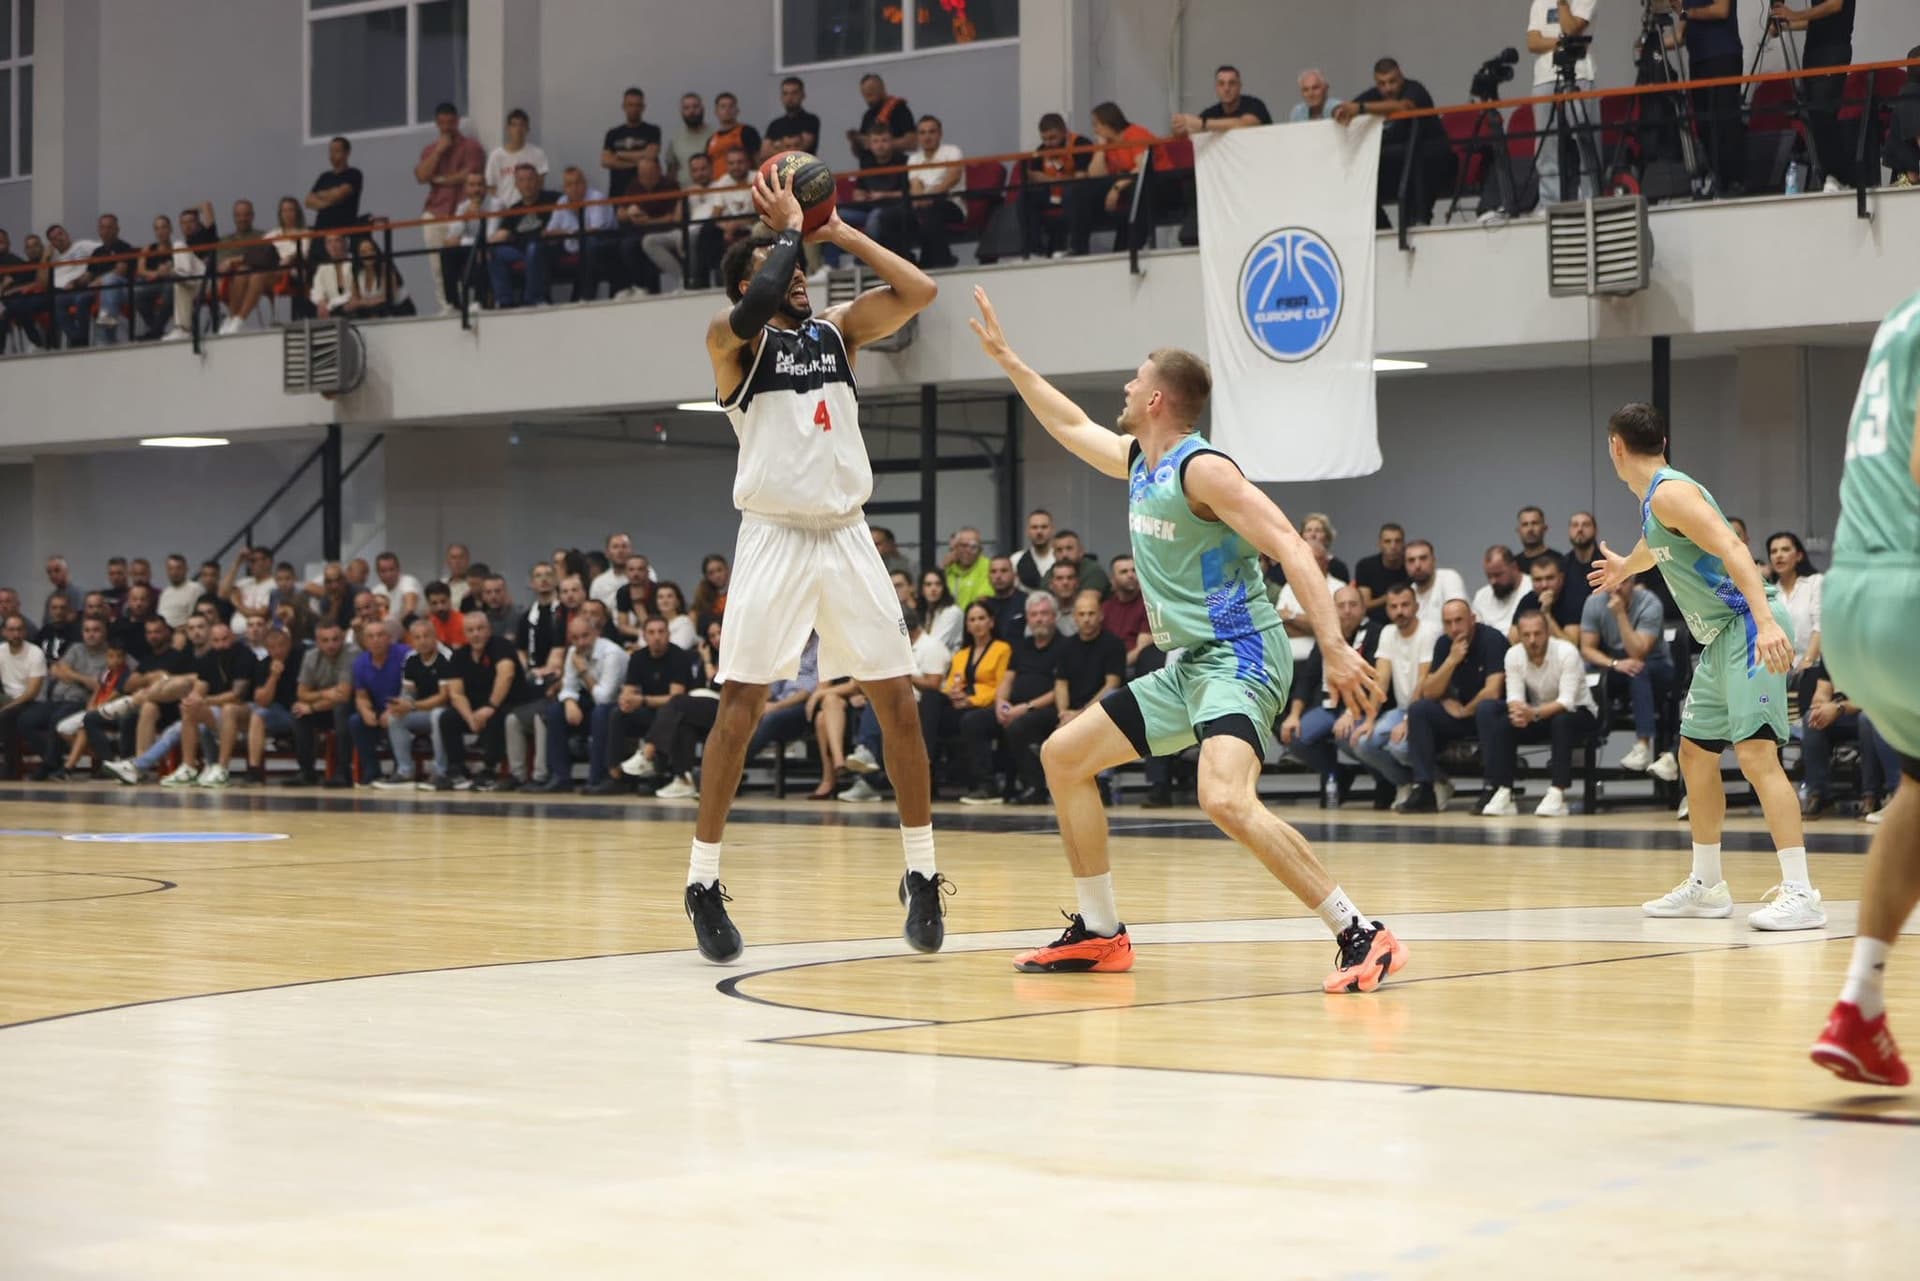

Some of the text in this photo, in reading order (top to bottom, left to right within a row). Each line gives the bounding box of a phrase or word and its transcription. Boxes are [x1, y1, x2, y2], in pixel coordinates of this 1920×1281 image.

[1254, 307, 1330, 323] EUROPE CUP
[813, 400, 832, 432] 4
